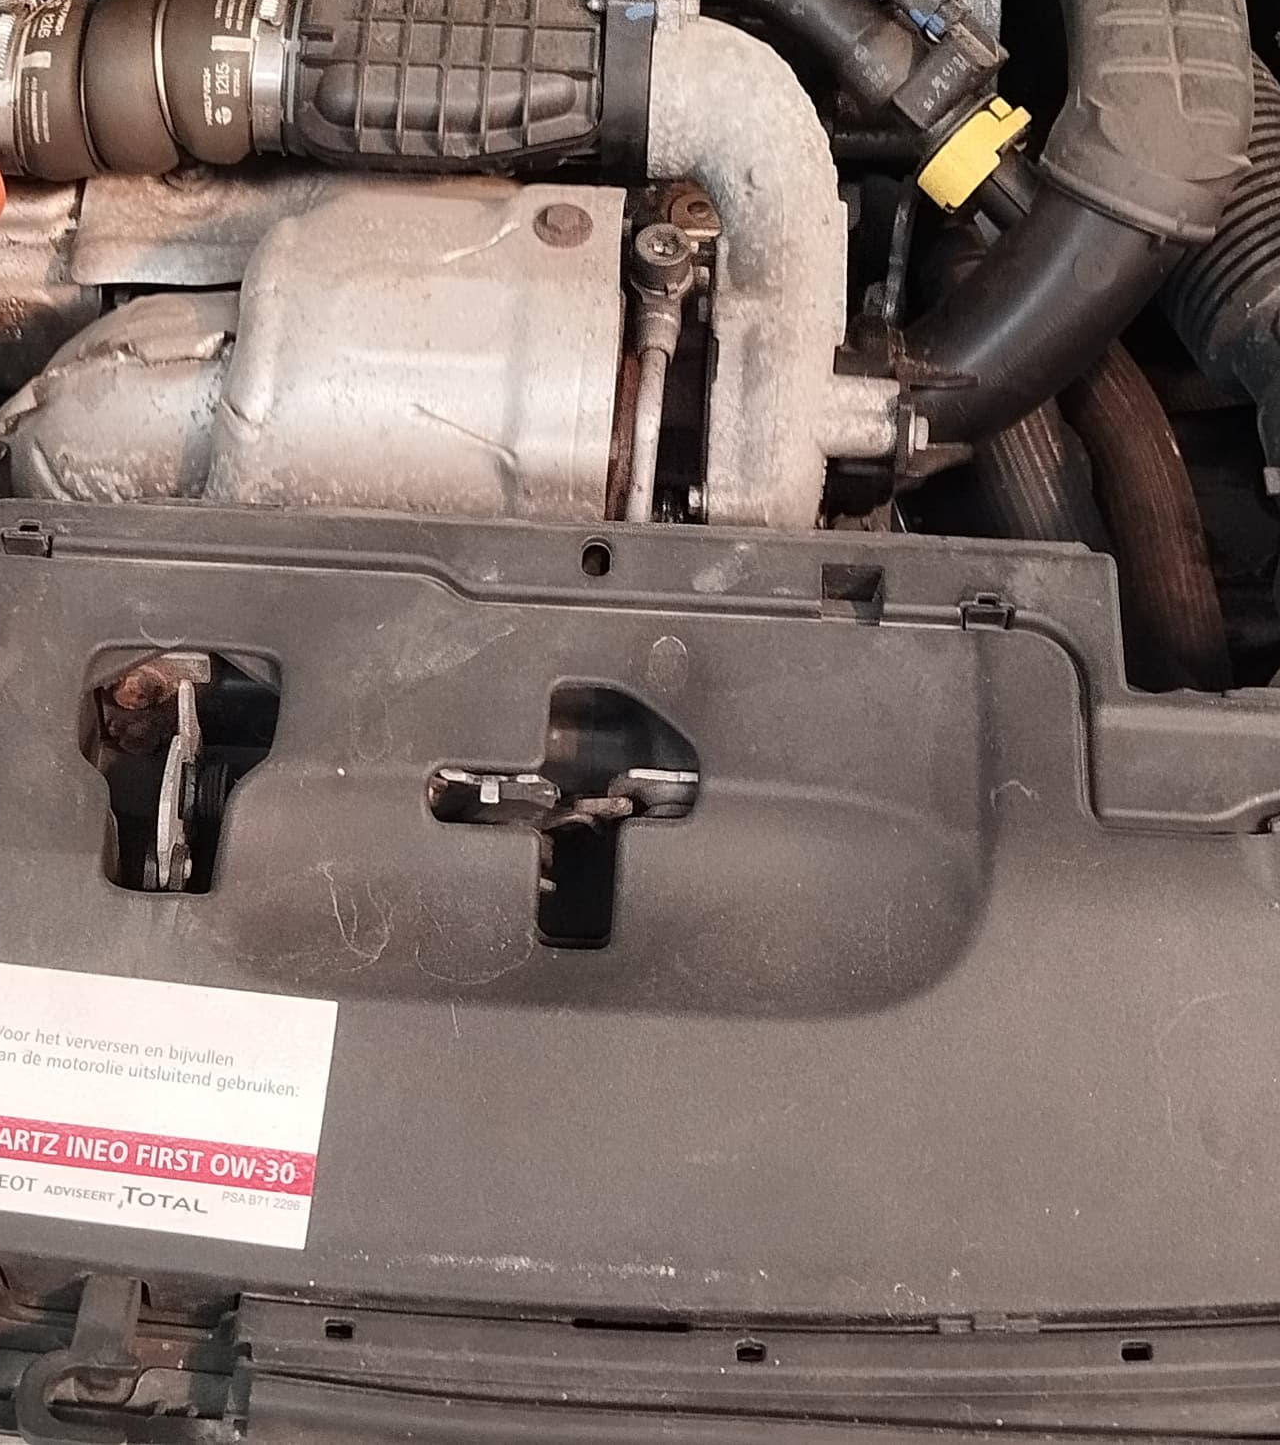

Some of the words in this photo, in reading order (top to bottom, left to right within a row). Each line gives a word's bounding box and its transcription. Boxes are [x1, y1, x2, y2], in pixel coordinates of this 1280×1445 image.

[35, 1029, 61, 1046] het
[65, 1035, 139, 1056] verversen
[144, 1043, 164, 1058] en
[169, 1045, 234, 1067] bijvullen
[22, 1049, 42, 1066] de
[46, 1055, 124, 1077] motorolie
[128, 1065, 212, 1087] uitsluitend
[216, 1075, 301, 1098] gebruiken:
[65, 1135, 129, 1164] INEO
[135, 1144, 205, 1173] FIRST
[43, 1185, 116, 1203] ADVISEERT
[221, 1190, 246, 1204] PSA
